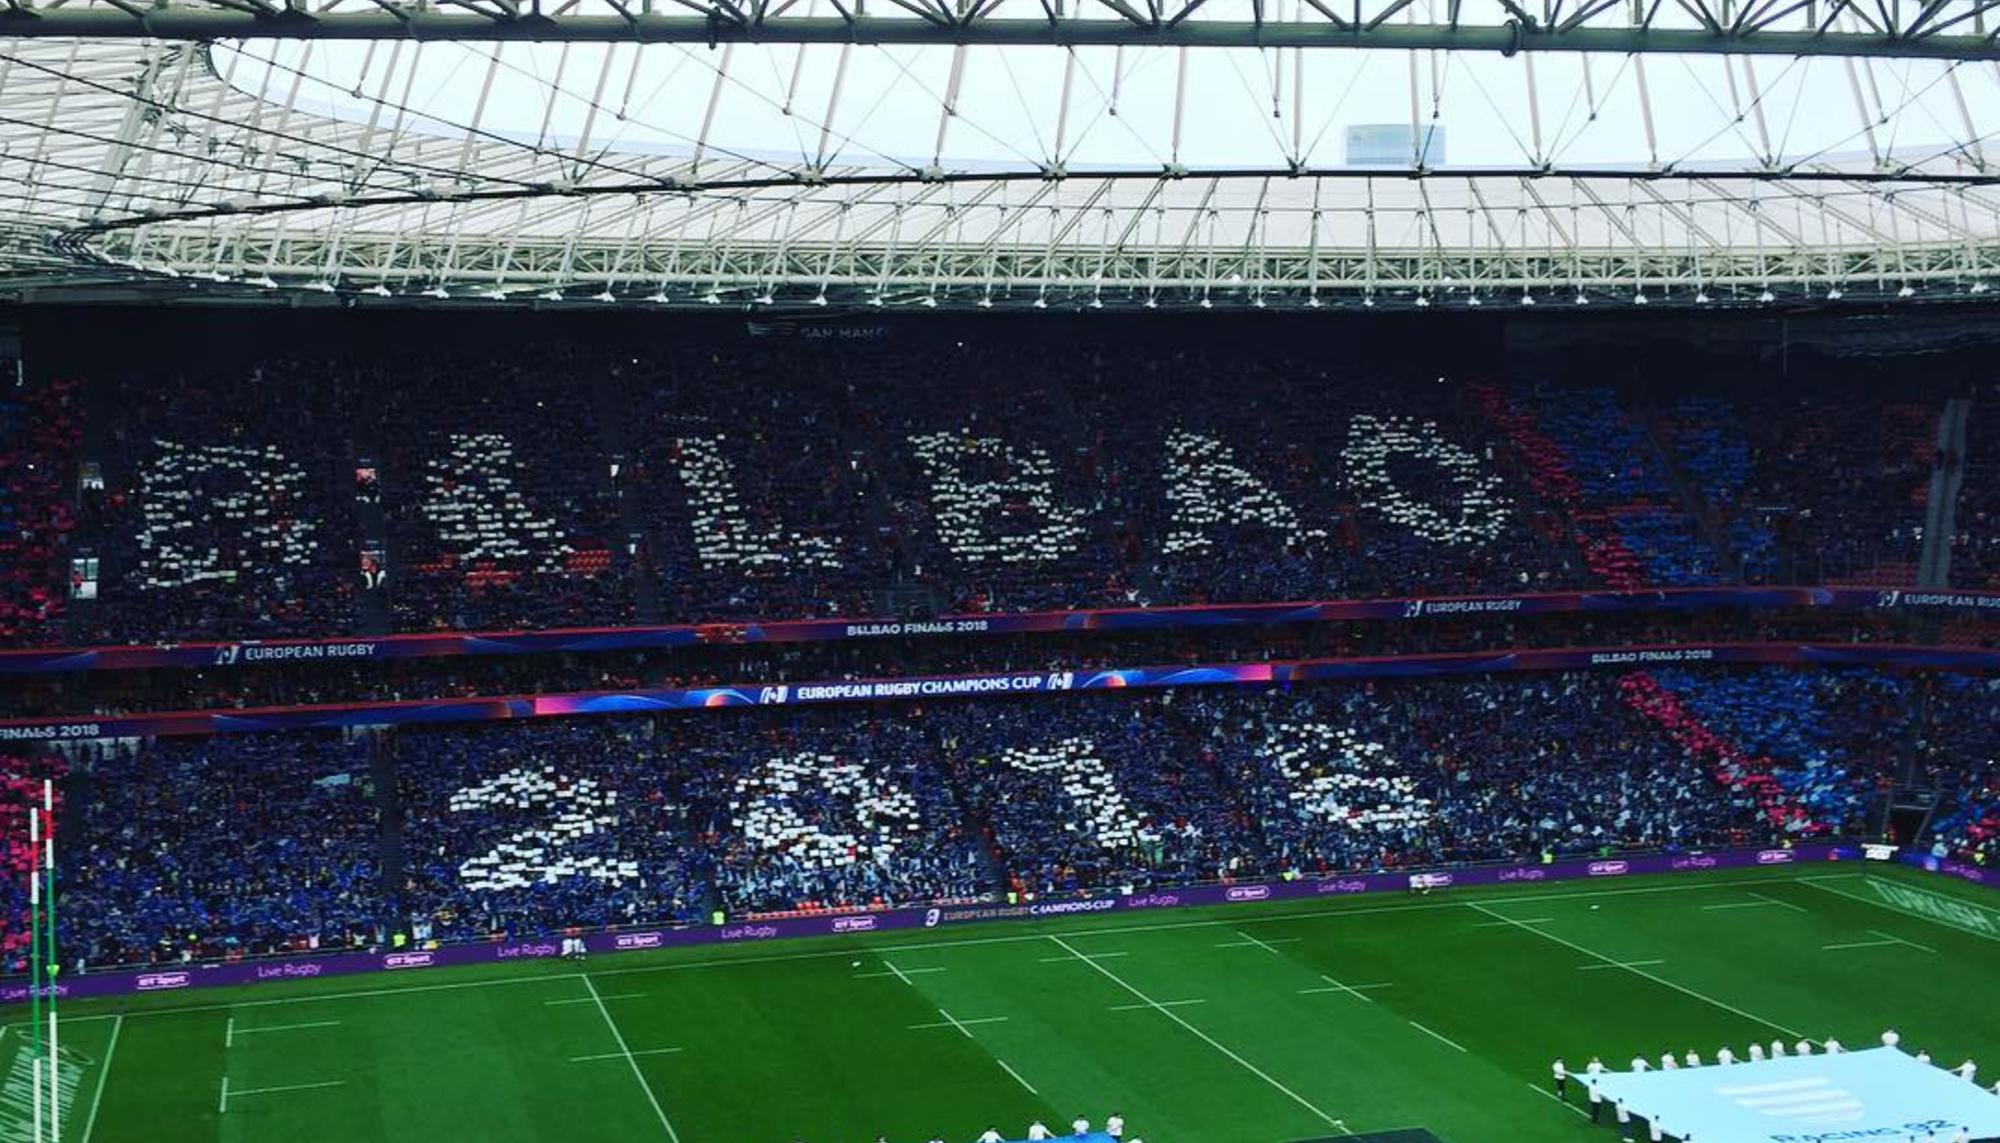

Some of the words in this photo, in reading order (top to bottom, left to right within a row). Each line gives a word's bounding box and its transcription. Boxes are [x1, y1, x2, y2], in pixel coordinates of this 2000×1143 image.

[847, 624, 901, 637] BILBAO
[904, 622, 954, 634] FINALS
[957, 620, 988, 633] 2018
[245, 646, 323, 660] EUROPEAN
[328, 643, 375, 656] RUGBY
[797, 685, 873, 700] EUROPEAN
[875, 682, 921, 696] RUGBY
[921, 677, 1010, 694] CHAMPIONS
[1012, 676, 1042, 689] CUP
[60, 724, 100, 737] 2018
[1128, 893, 1147, 907] Live
[1150, 893, 1179, 906] Rugby
[721, 928, 743, 939] Live
[744, 924, 777, 938] Rugby
[497, 946, 520, 957] Live
[522, 943, 556, 956] Rugby
[258, 965, 282, 978] Live
[283, 962, 322, 977] Rugby
